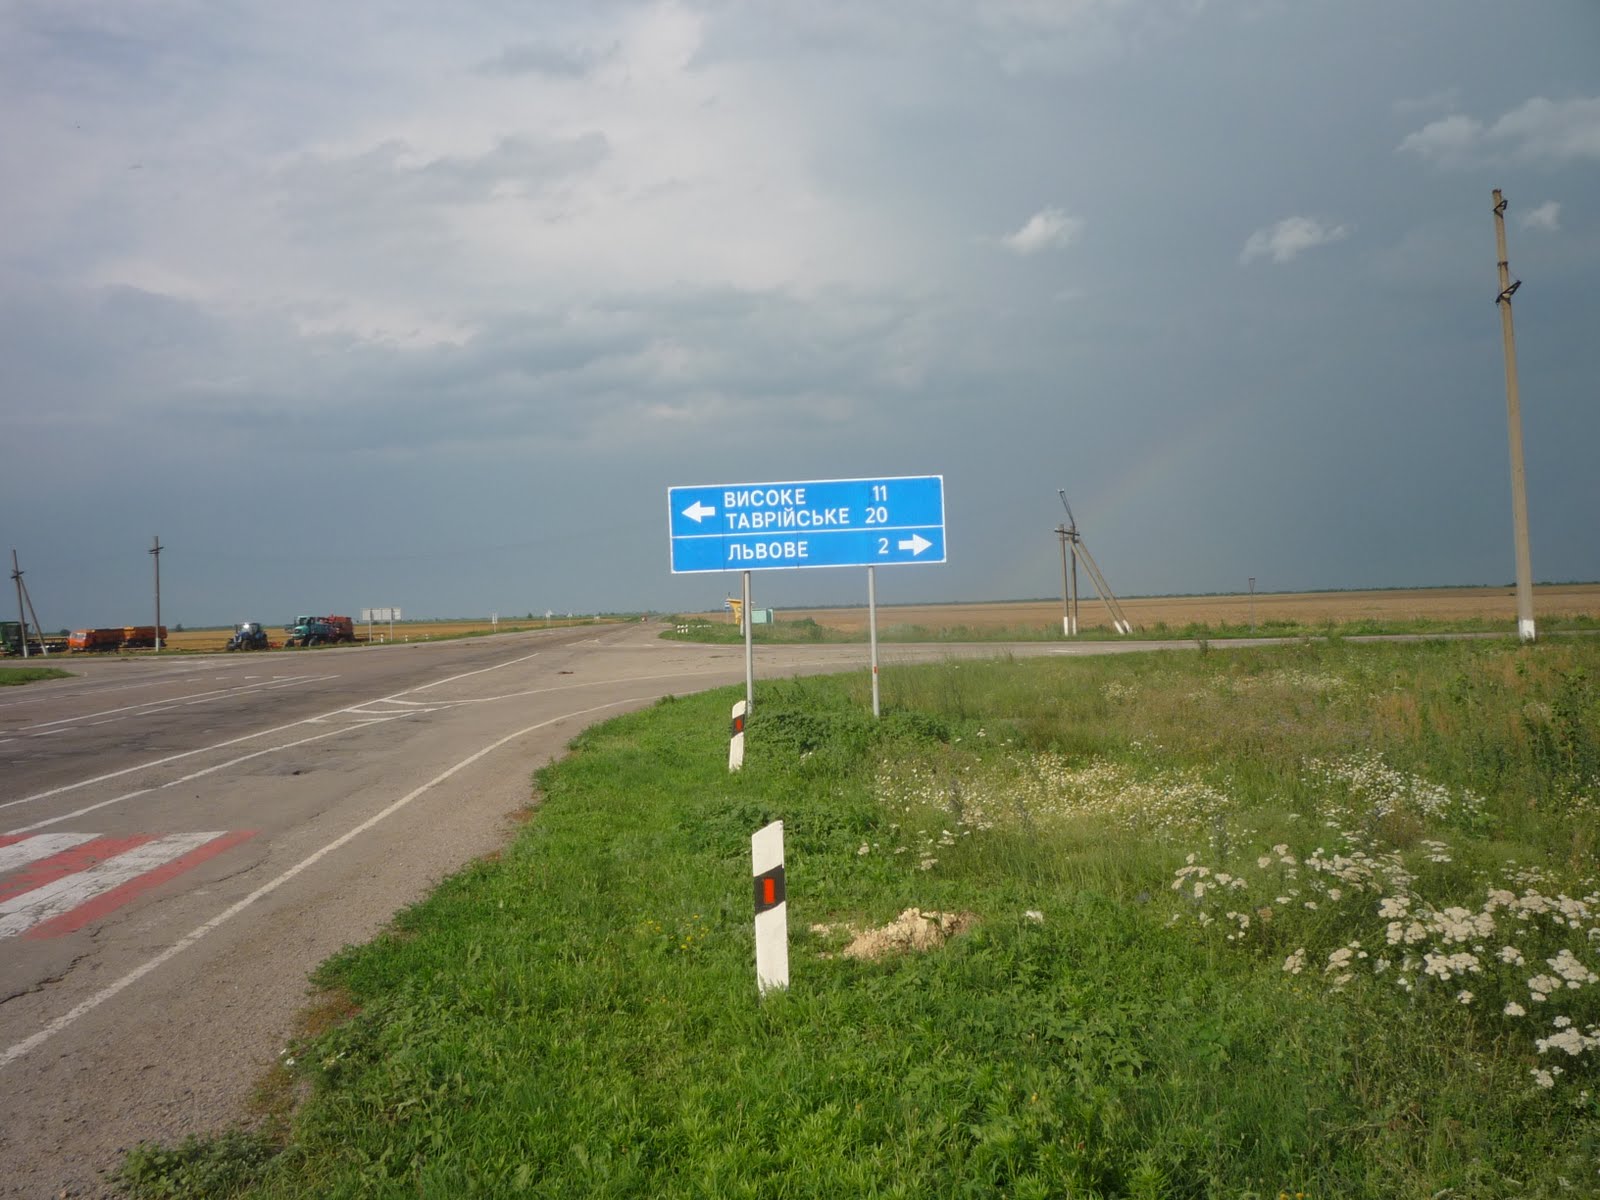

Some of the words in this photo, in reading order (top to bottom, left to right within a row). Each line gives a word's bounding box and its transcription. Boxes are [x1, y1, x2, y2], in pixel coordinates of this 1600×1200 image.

[724, 488, 806, 508] ВИСОКЕ
[872, 485, 887, 502] 11
[725, 507, 850, 529] ТАВРІЙСЬКЕ
[865, 506, 888, 524] 20
[727, 540, 809, 561] ЛЬВОВЕ
[878, 537, 889, 554] 2
